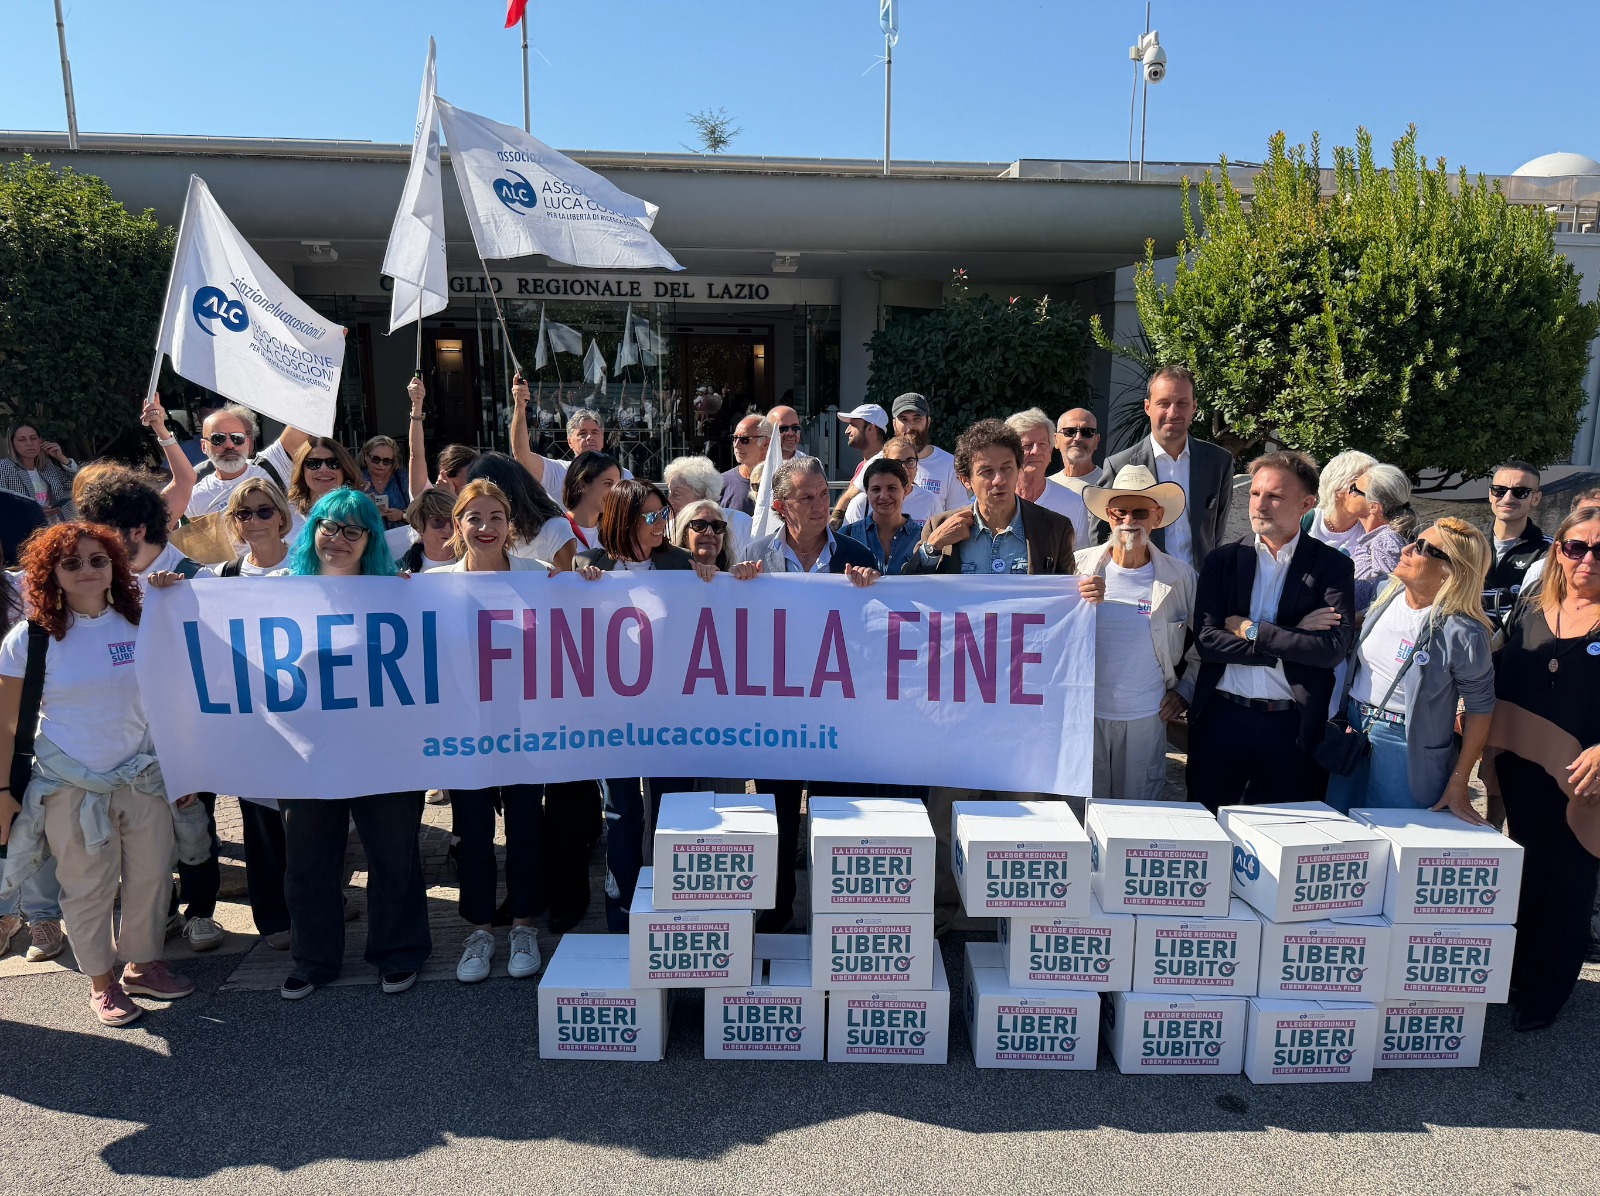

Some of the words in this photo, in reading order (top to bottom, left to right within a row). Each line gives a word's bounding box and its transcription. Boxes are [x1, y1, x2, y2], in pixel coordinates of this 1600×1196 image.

[502, 186, 530, 202] ALC
[544, 196, 584, 210] LUCA
[546, 211, 558, 219] PER
[559, 212, 567, 220] LA
[567, 211, 592, 221] LIBERTÀ
[379, 275, 503, 294] CGLIO
[516, 277, 642, 297] REGIONALE
[653, 281, 695, 298] DEL
[706, 282, 770, 300] LAZIO
[202, 295, 244, 324] ALC
[274, 350, 334, 383] COSCIONI
[183, 610, 441, 715] LIBERI
[477, 606, 654, 702] FINO
[681, 607, 856, 699] ALLA
[886, 611, 1046, 706] FINE
[422, 721, 838, 757] associazionelucacoscioni.it
[673, 854, 754, 872] LIBERI
[831, 856, 912, 875] LIBERI
[1331, 853, 1368, 861] REGIONALE
[986, 861, 1067, 879] LIBERI
[1125, 858, 1208, 879] LIBERI
[1295, 861, 1368, 884] LIBERI
[1416, 867, 1498, 886] LIBERI
[672, 875, 754, 891] SUBITO
[831, 877, 912, 894] SUBITO
[986, 882, 1067, 898] SUBITO
[1124, 879, 1207, 898] SUBITO
[1293, 881, 1367, 903] SUBITO
[1415, 888, 1497, 905] SUBITO
[649, 932, 729, 952] LIBERI
[831, 935, 911, 954] LIBERI
[1030, 934, 1111, 956] LIBERI
[1155, 938, 1237, 959] LIBERI
[1448, 938, 1490, 946] REGIONALE
[649, 952, 730, 970] SUBITO
[831, 956, 911, 972] SUBITO
[1029, 955, 1110, 974] SUBITO
[1282, 945, 1365, 965] LIBERI
[1407, 945, 1491, 966] LIBERI
[1154, 959, 1236, 977] SUBITO
[1281, 965, 1364, 983] SUBITO
[1405, 965, 1489, 985] SUBITO
[557, 1006, 637, 1026] LIBERI
[723, 1006, 802, 1024] LIBERI
[847, 1009, 926, 1029] LIBERI
[997, 1015, 1077, 1034] LIBERI
[1384, 1015, 1463, 1034] LIBERI
[557, 1026, 637, 1044] SUBITO
[723, 1026, 802, 1042] SUBITO
[847, 1029, 926, 1047] SUBITO
[1143, 1020, 1223, 1039] LIBERI
[1274, 1029, 1355, 1048] LIBERI
[996, 1035, 1076, 1053] SUBITO
[1142, 1041, 1222, 1057] SUBITO
[1383, 1035, 1462, 1052] SUBITO
[1273, 1049, 1353, 1066] SUBITO
